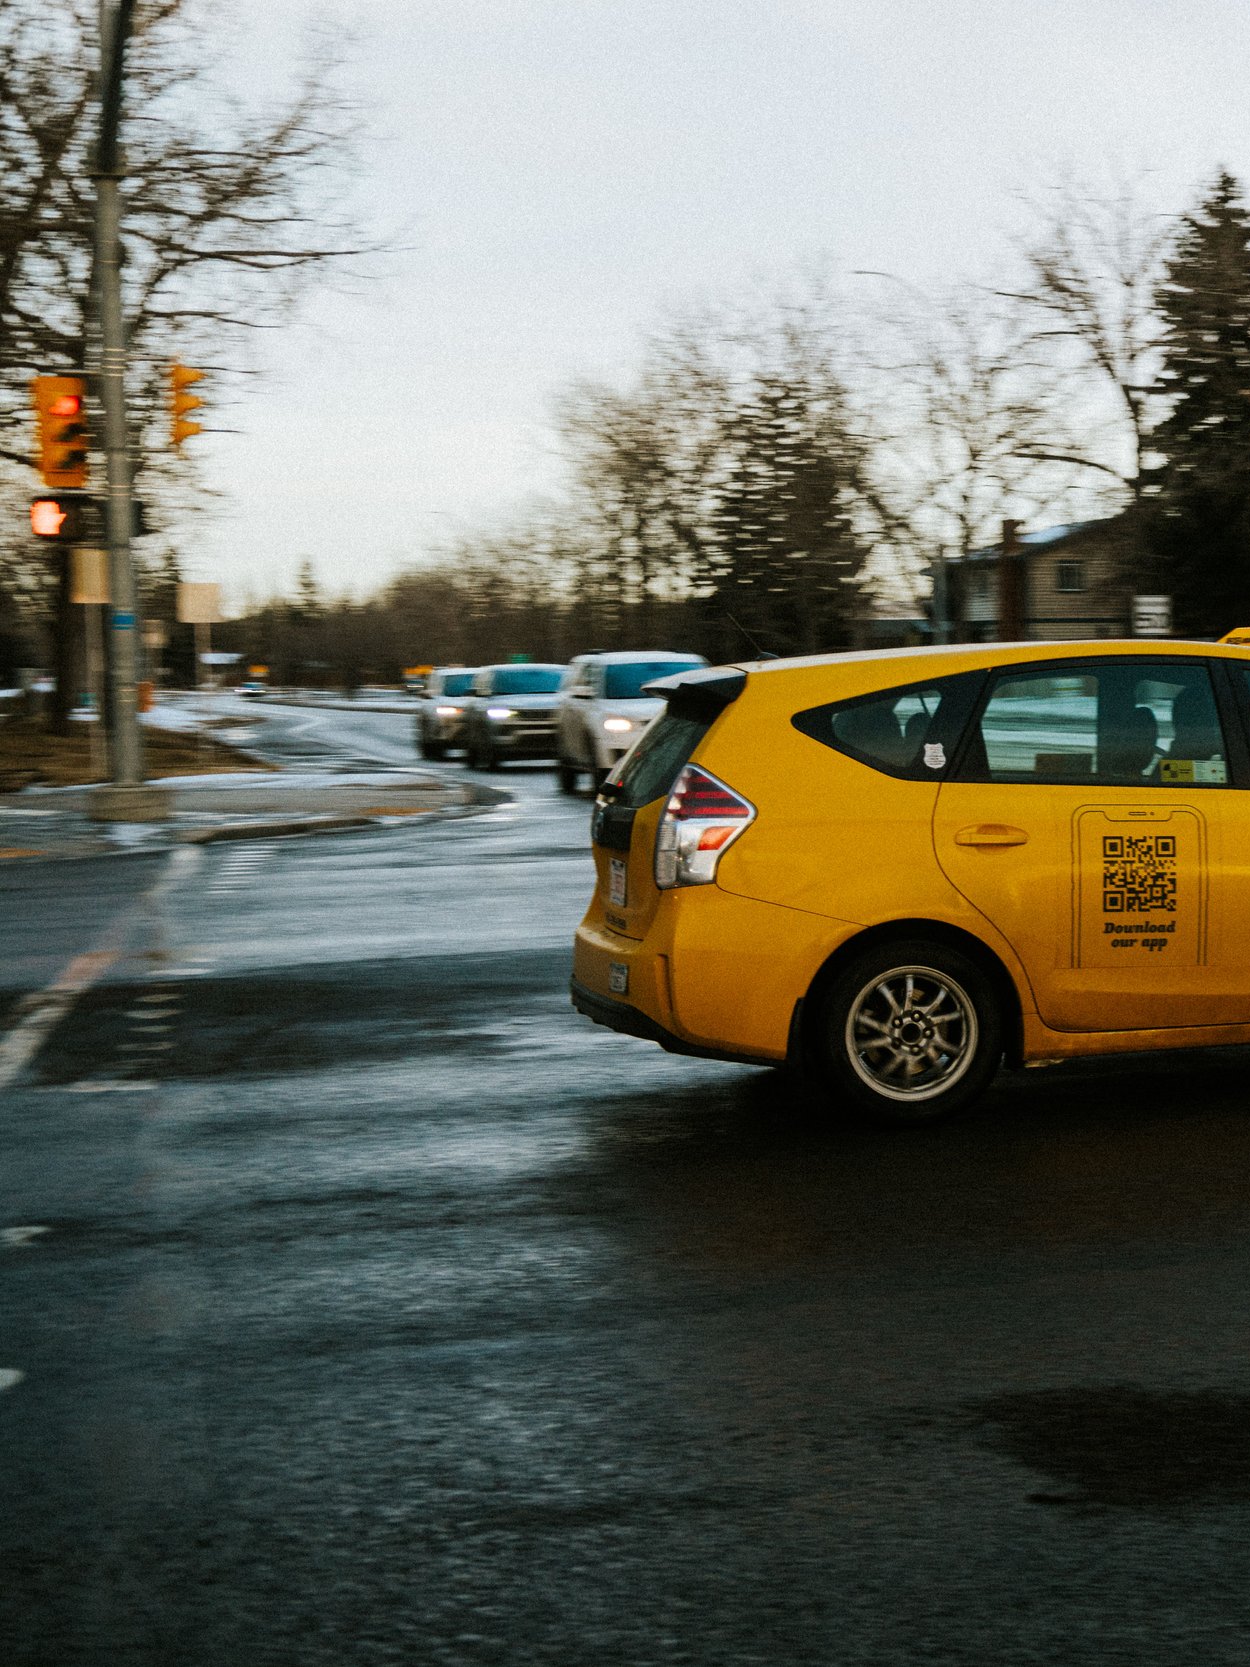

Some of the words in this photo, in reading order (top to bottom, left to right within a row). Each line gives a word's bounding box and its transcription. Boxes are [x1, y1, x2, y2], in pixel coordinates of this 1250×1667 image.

[1104, 921, 1176, 934] Download
[1112, 938, 1138, 948] our
[1142, 938, 1168, 952] app
